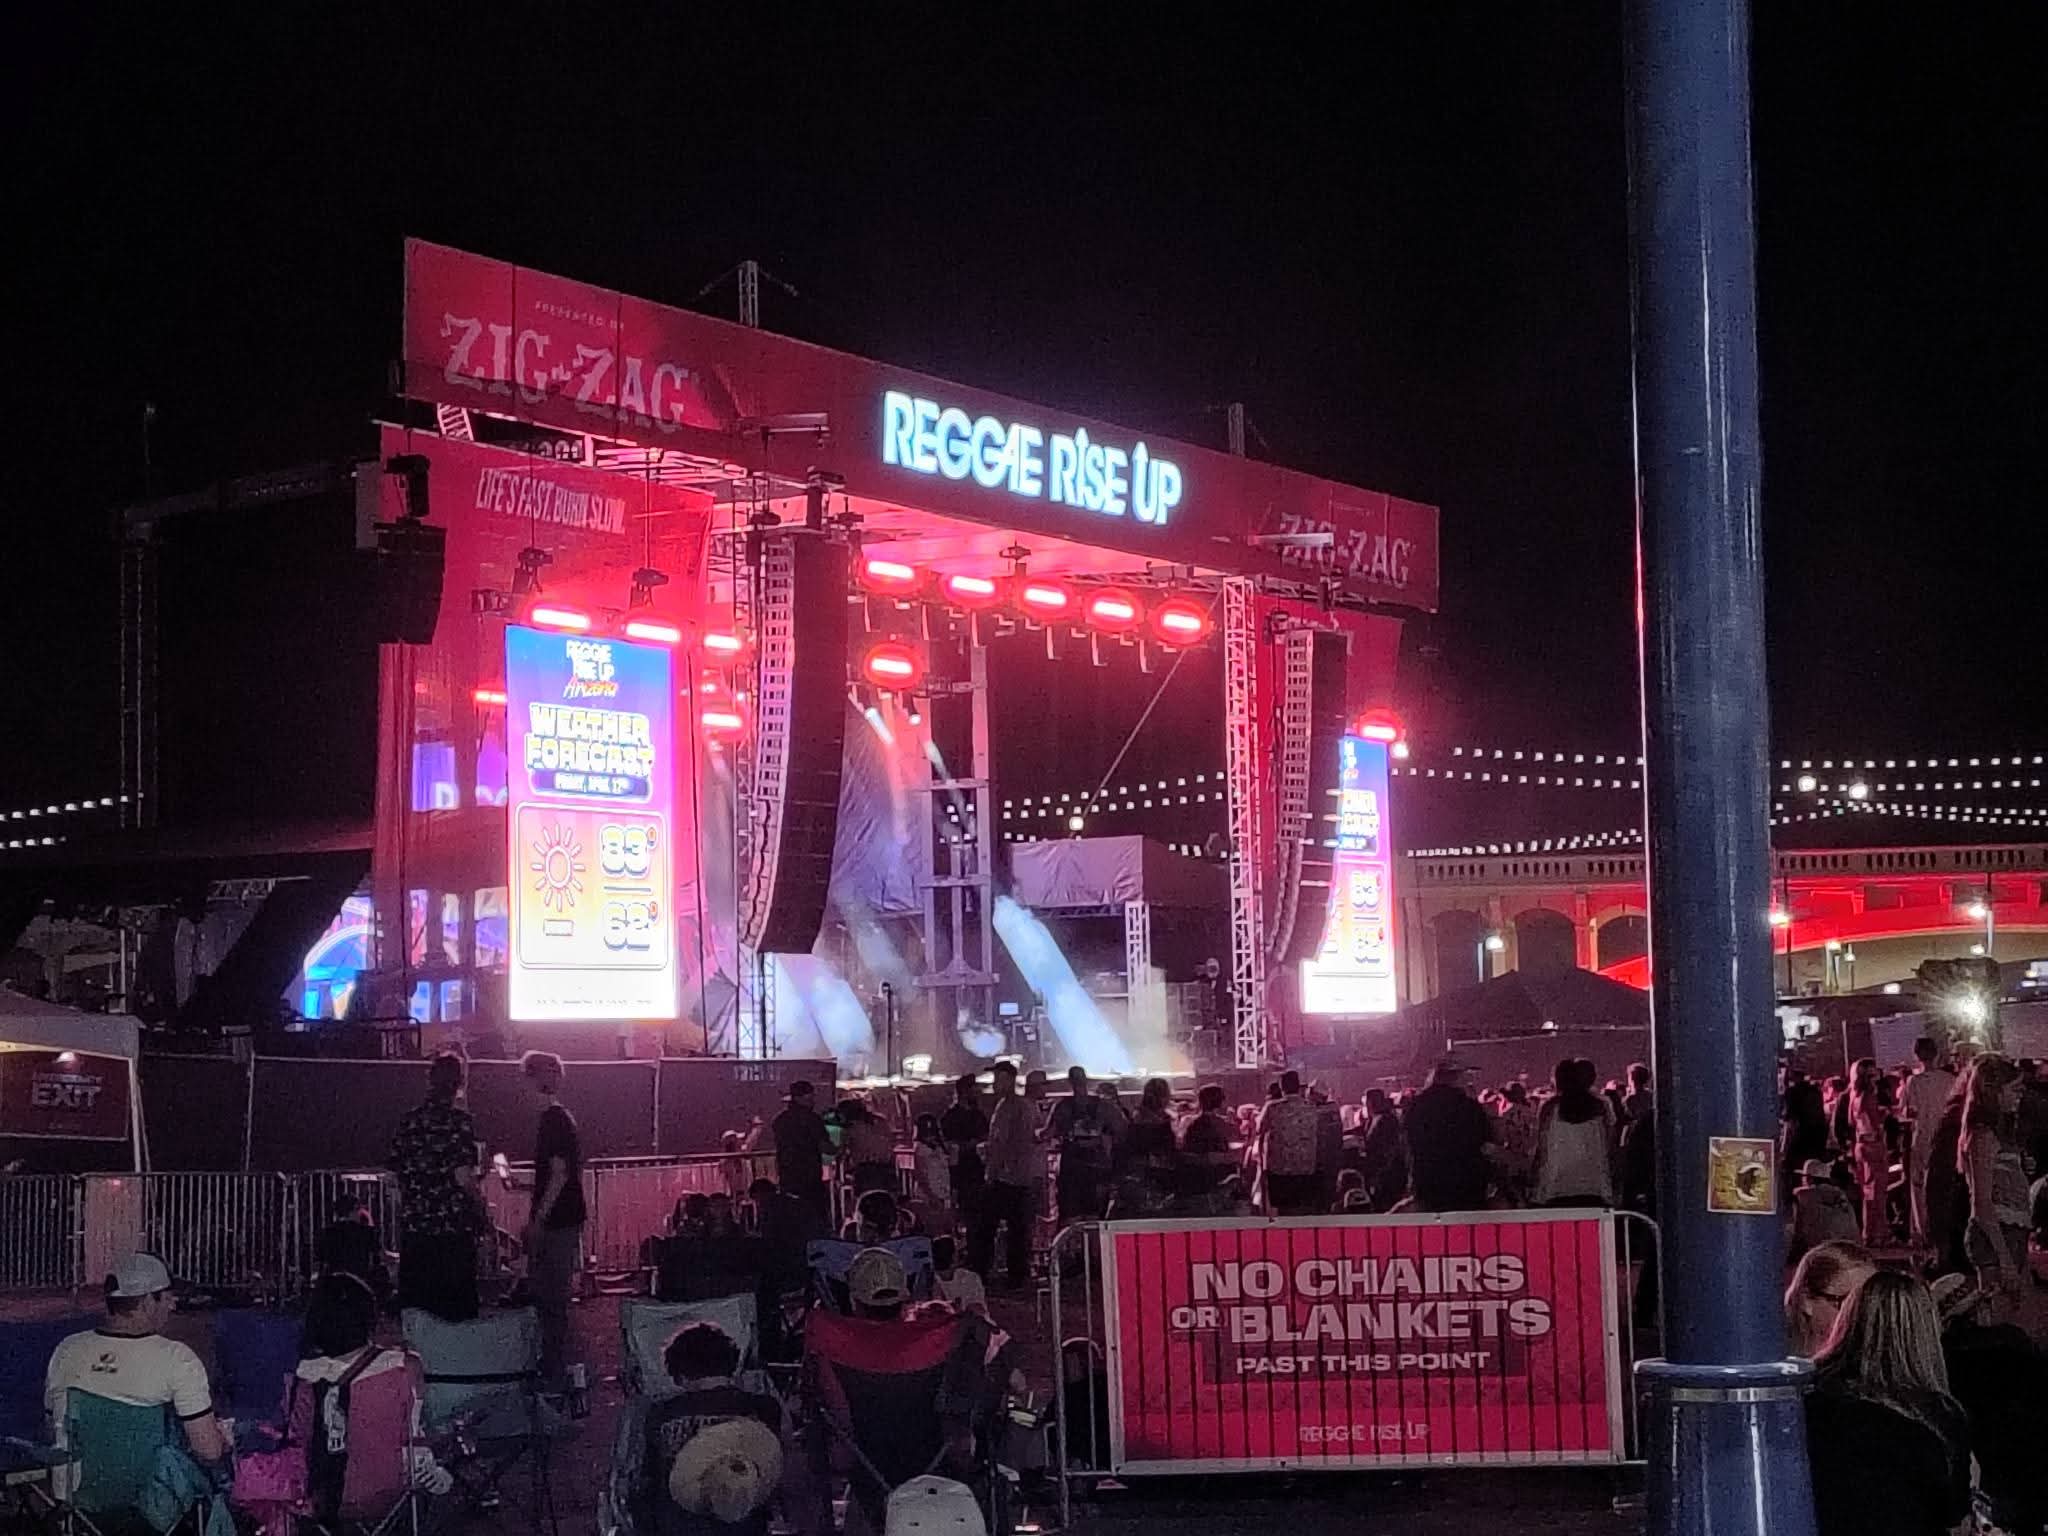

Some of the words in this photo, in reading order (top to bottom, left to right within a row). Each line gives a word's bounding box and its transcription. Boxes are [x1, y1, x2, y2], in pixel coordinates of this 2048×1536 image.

[440, 312, 689, 433] ZIG-ZAG
[882, 389, 1043, 498] REGGAE
[1050, 427, 1130, 516] RISE
[1132, 441, 1183, 525] UP
[553, 486, 589, 528] BURN
[530, 704, 649, 747] WEATHER
[527, 735, 653, 776] FORECAST
[32, 1082, 102, 1107] EXIT
[1192, 1261, 1283, 1300] NO
[1295, 1255, 1524, 1296] CHAIRS
[1171, 1305, 1220, 1330] OR
[1229, 1299, 1551, 1343] BLANKETS
[1237, 1355, 1314, 1374] PAST
[1321, 1353, 1391, 1372] THIS
[1399, 1351, 1491, 1370] POINT
